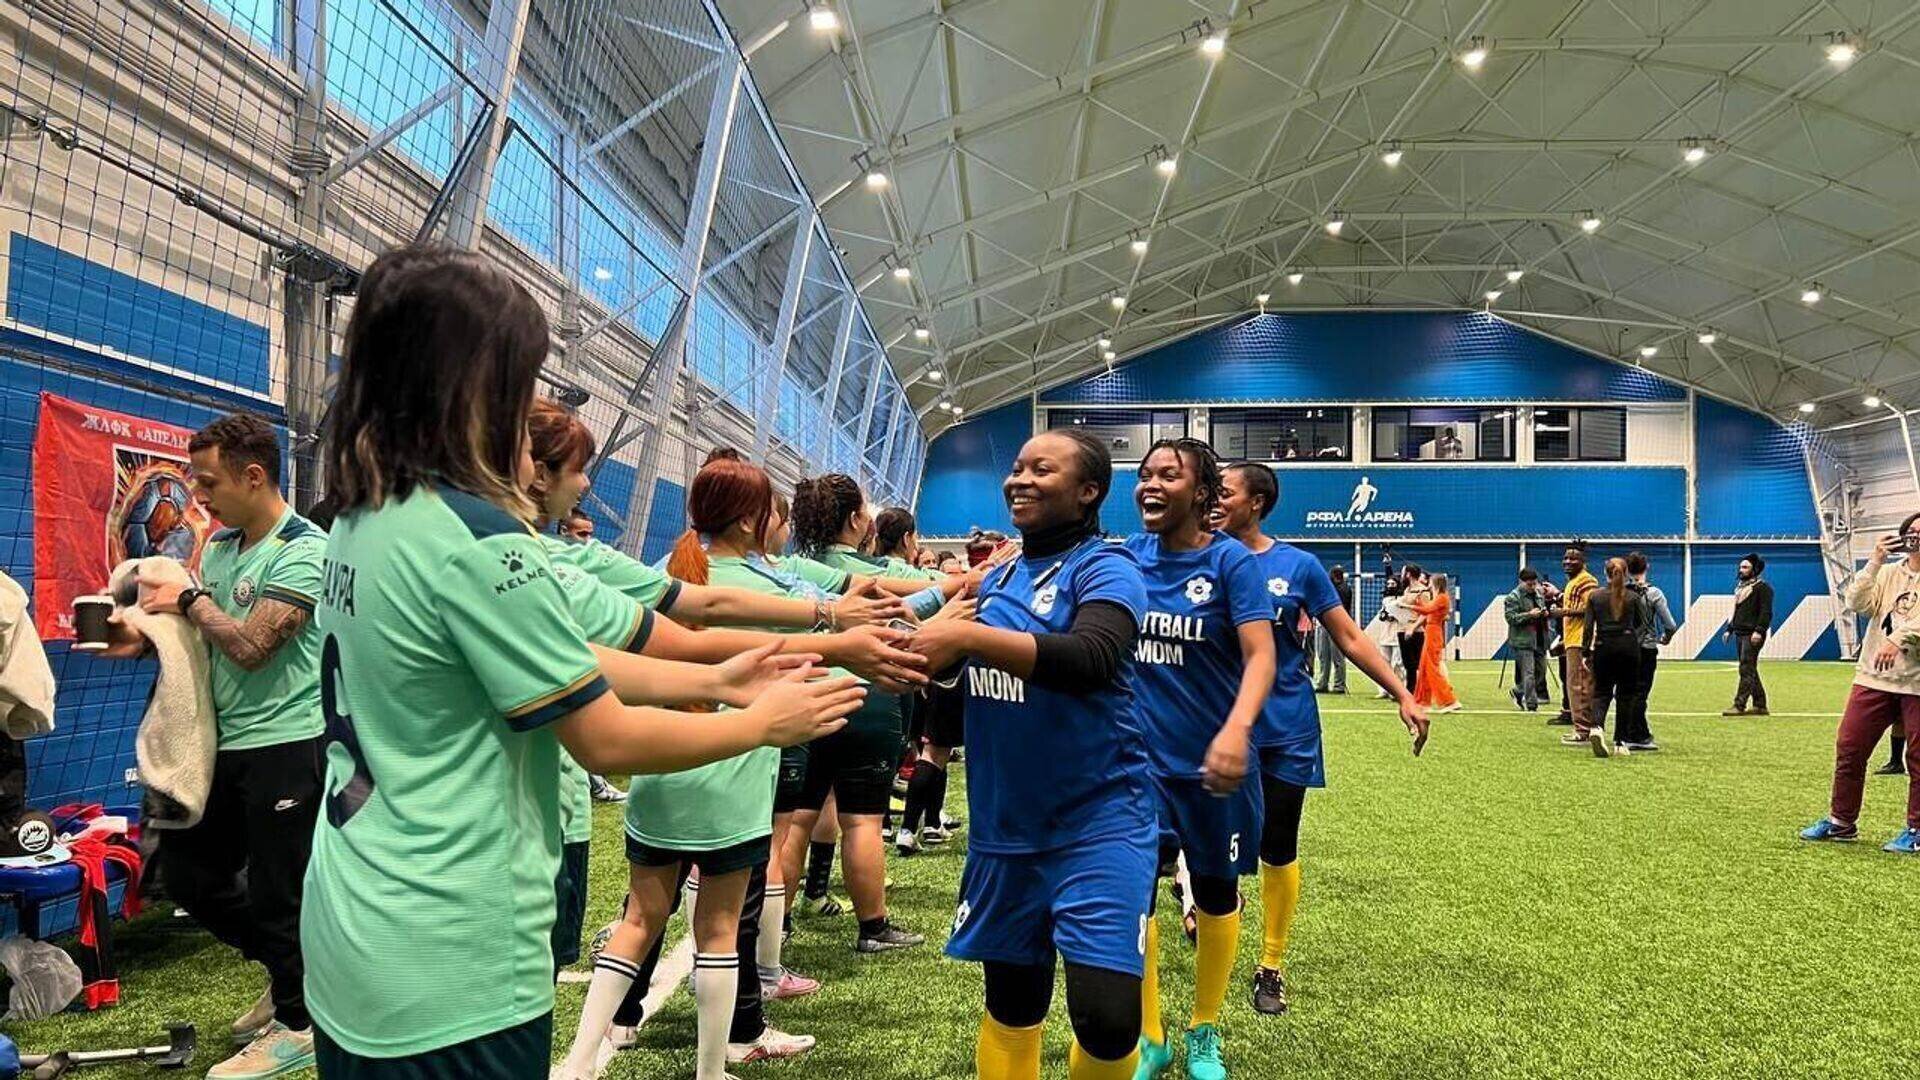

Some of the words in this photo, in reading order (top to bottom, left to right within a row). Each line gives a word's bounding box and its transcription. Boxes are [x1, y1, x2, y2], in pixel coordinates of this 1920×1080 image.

[81, 413, 132, 438] ЖЛФК
[136, 427, 192, 450] «АПЕЛЬ
[1306, 511, 1344, 522] РФЛ
[1362, 511, 1414, 522] АРЕНА
[494, 567, 546, 595] KELME
[1134, 638, 1184, 667] MOM
[968, 665, 1025, 703] MOM
[1229, 832, 1240, 862] 5
